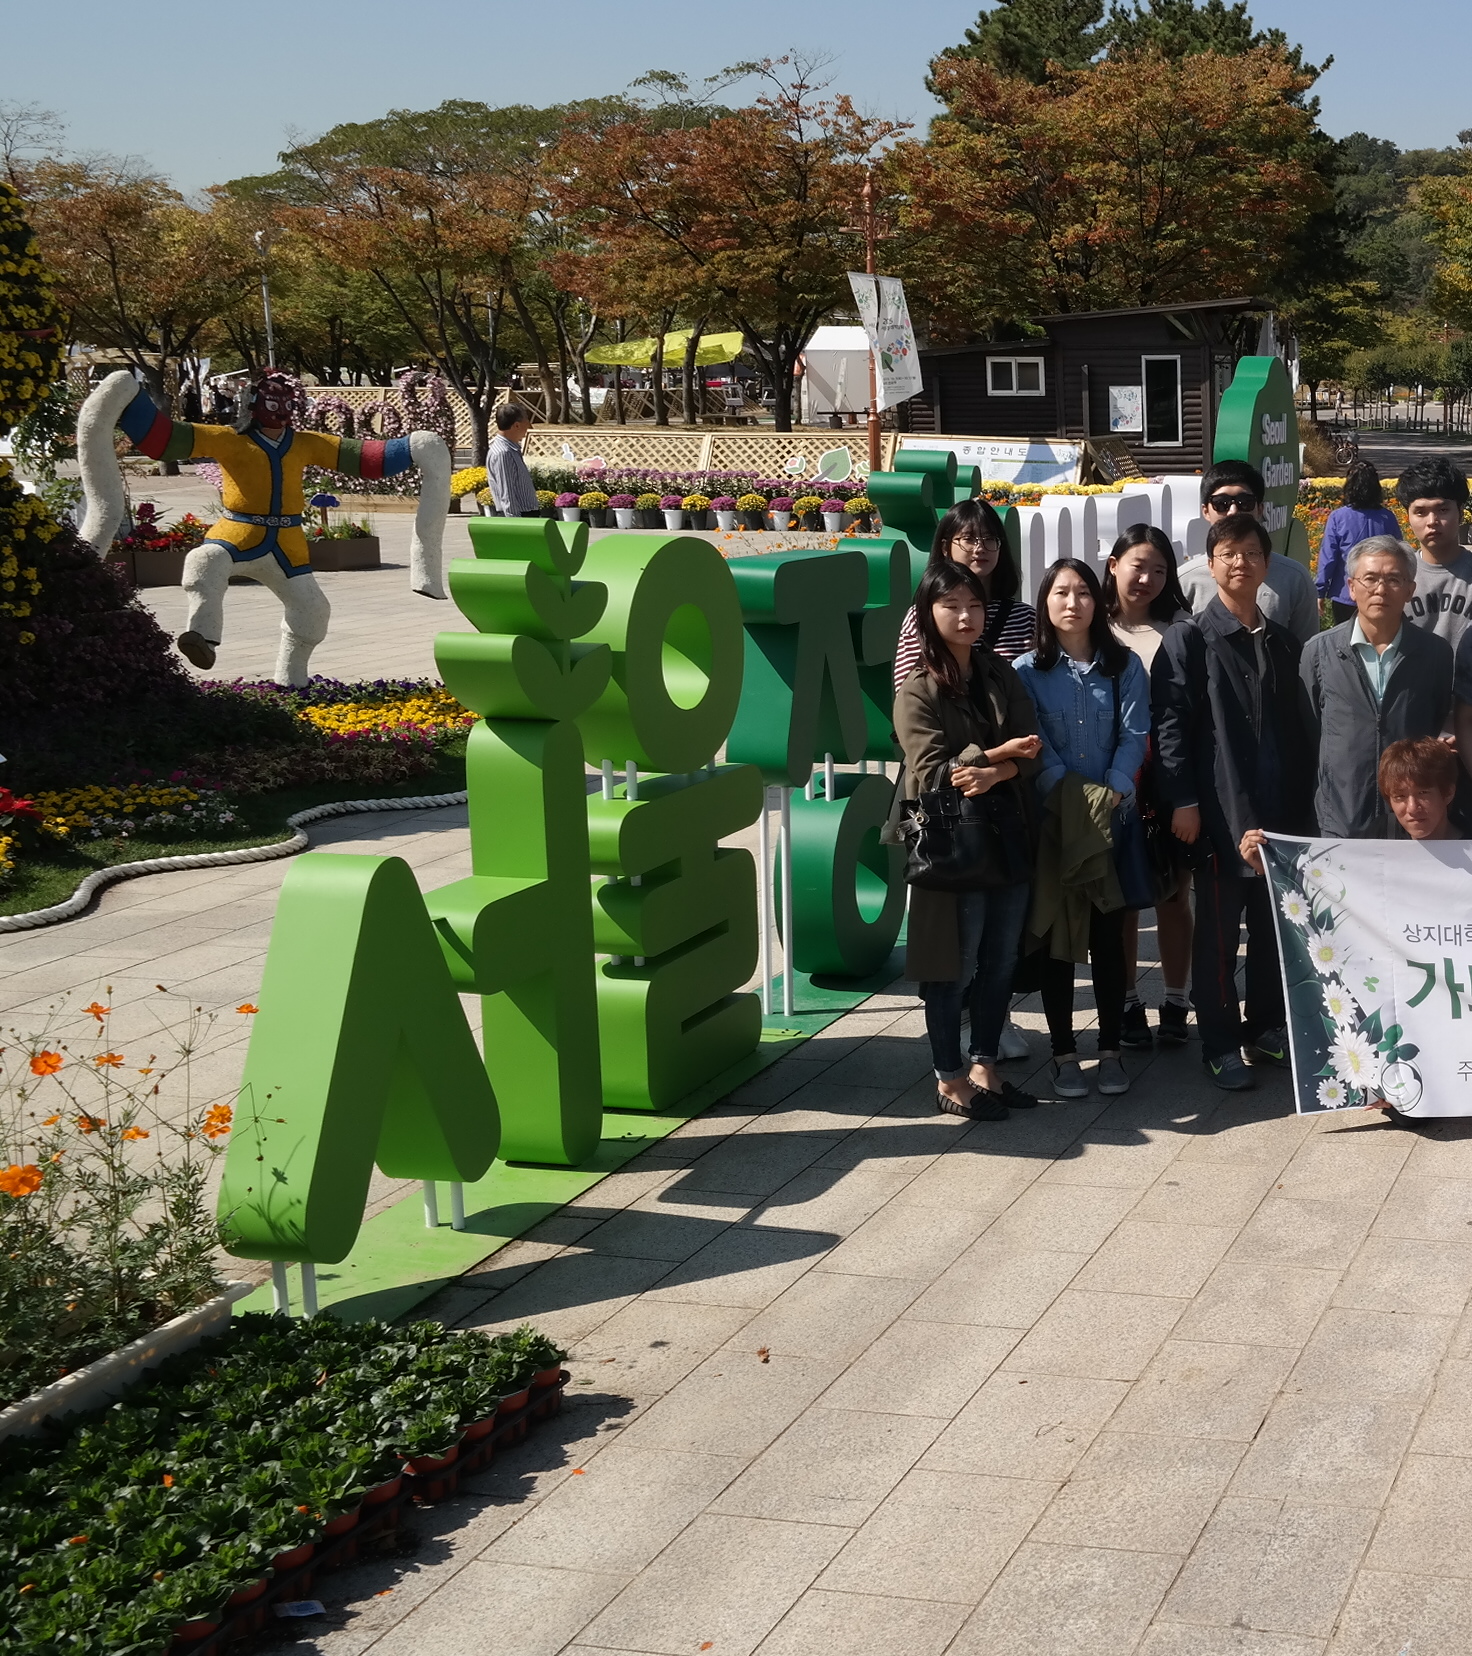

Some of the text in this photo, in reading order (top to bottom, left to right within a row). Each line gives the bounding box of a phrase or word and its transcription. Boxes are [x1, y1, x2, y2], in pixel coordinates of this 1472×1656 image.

[1261, 412, 1287, 446] Seoul
[962, 445, 1028, 457] 종합안내도
[1261, 455, 1294, 488] Garden
[1262, 501, 1288, 533] Show
